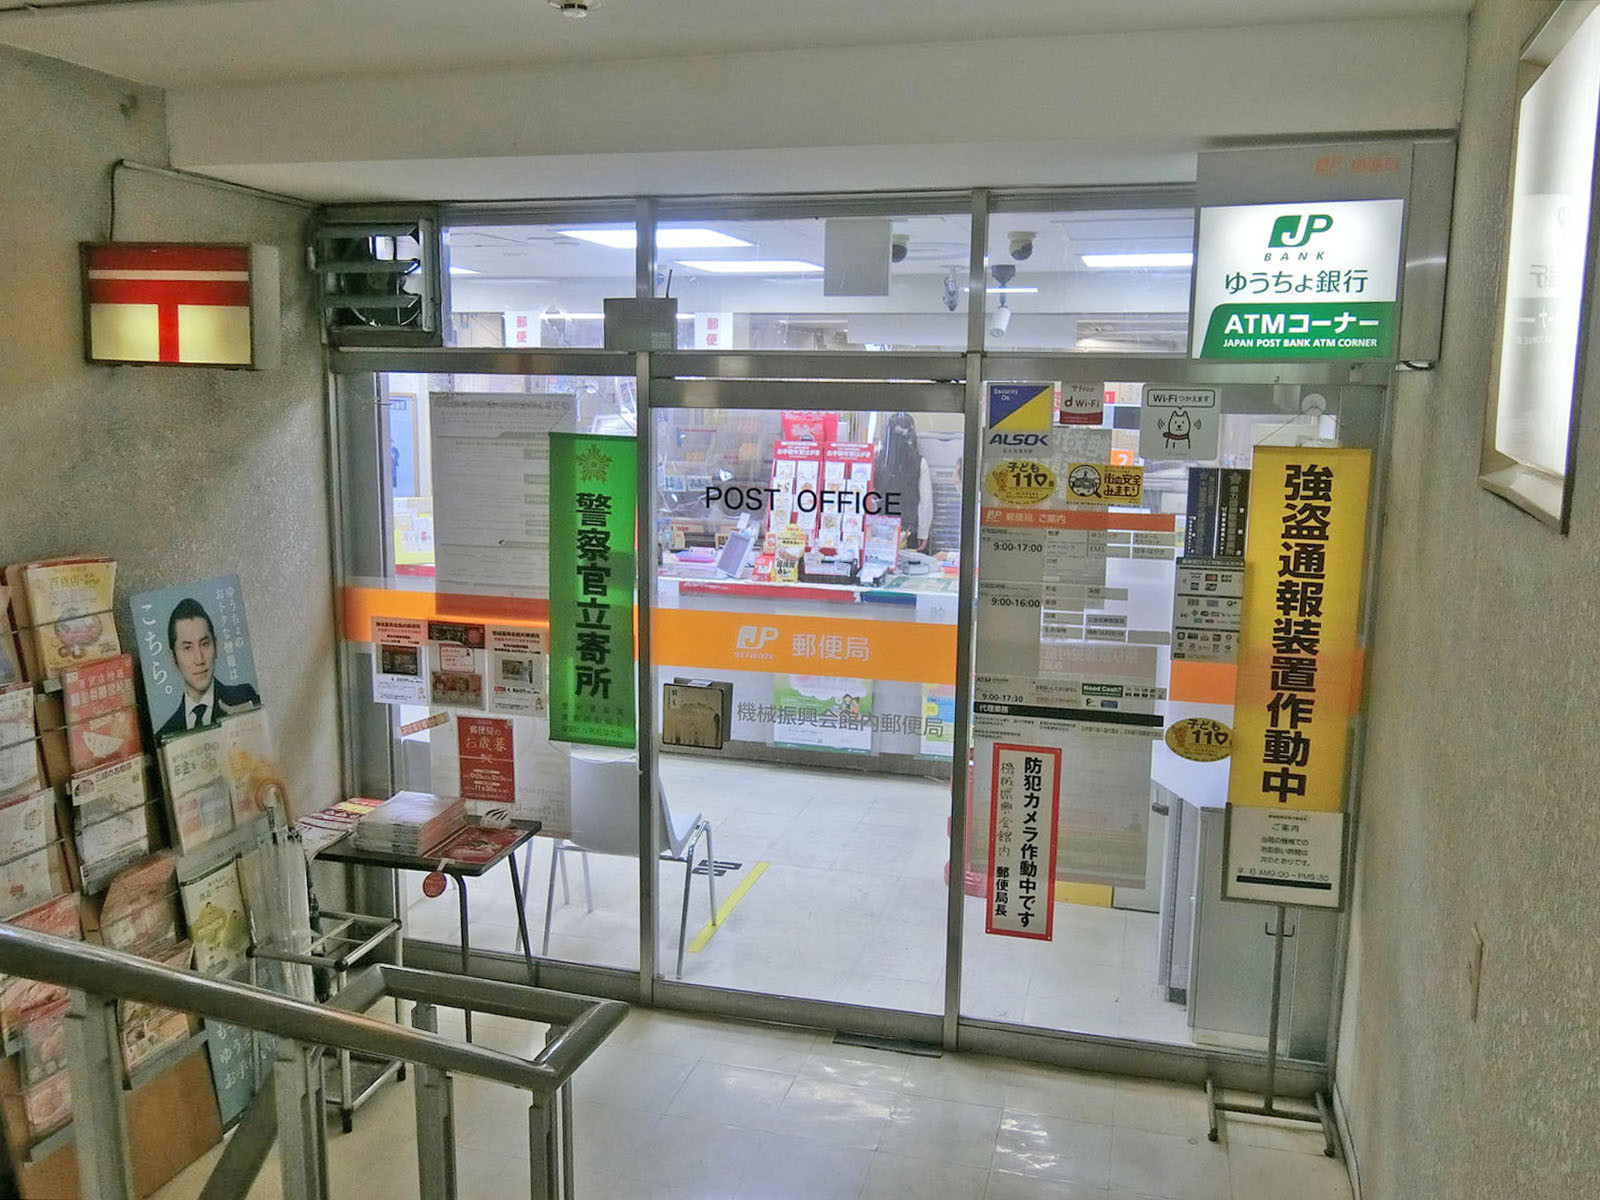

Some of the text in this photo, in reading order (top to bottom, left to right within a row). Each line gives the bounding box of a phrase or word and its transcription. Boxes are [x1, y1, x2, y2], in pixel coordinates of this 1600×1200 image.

[1264, 251, 1325, 262] BANK
[1225, 269, 1369, 294] ゆうちょ銀行
[516, 316, 528, 348] 郵便
[1224, 312, 1379, 334] ATMコーナー
[1223, 338, 1378, 347] JAPAN POST BANK ATM CORNER
[993, 388, 1018, 396] Security
[989, 434, 1049, 446] ALSOK
[1007, 462, 1040, 473] 子ども
[1104, 485, 1140, 497] みまもり
[705, 486, 902, 516] POST OFFICE
[993, 542, 1043, 553] 9:00-17:00
[575, 492, 613, 699] 警察官立寄所
[991, 597, 1041, 608] 9:00-16:00
[1262, 464, 1335, 803] 強盗通報装置作動中
[792, 633, 870, 662] 郵便局
[736, 700, 943, 738] 機械振興会館内郵便局
[1187, 718, 1221, 731] 子ども
[1192, 730, 1232, 746] 110
[1017, 756, 1043, 928] 防犯カメラ作動中です
[995, 866, 1010, 918] 郵便局長
